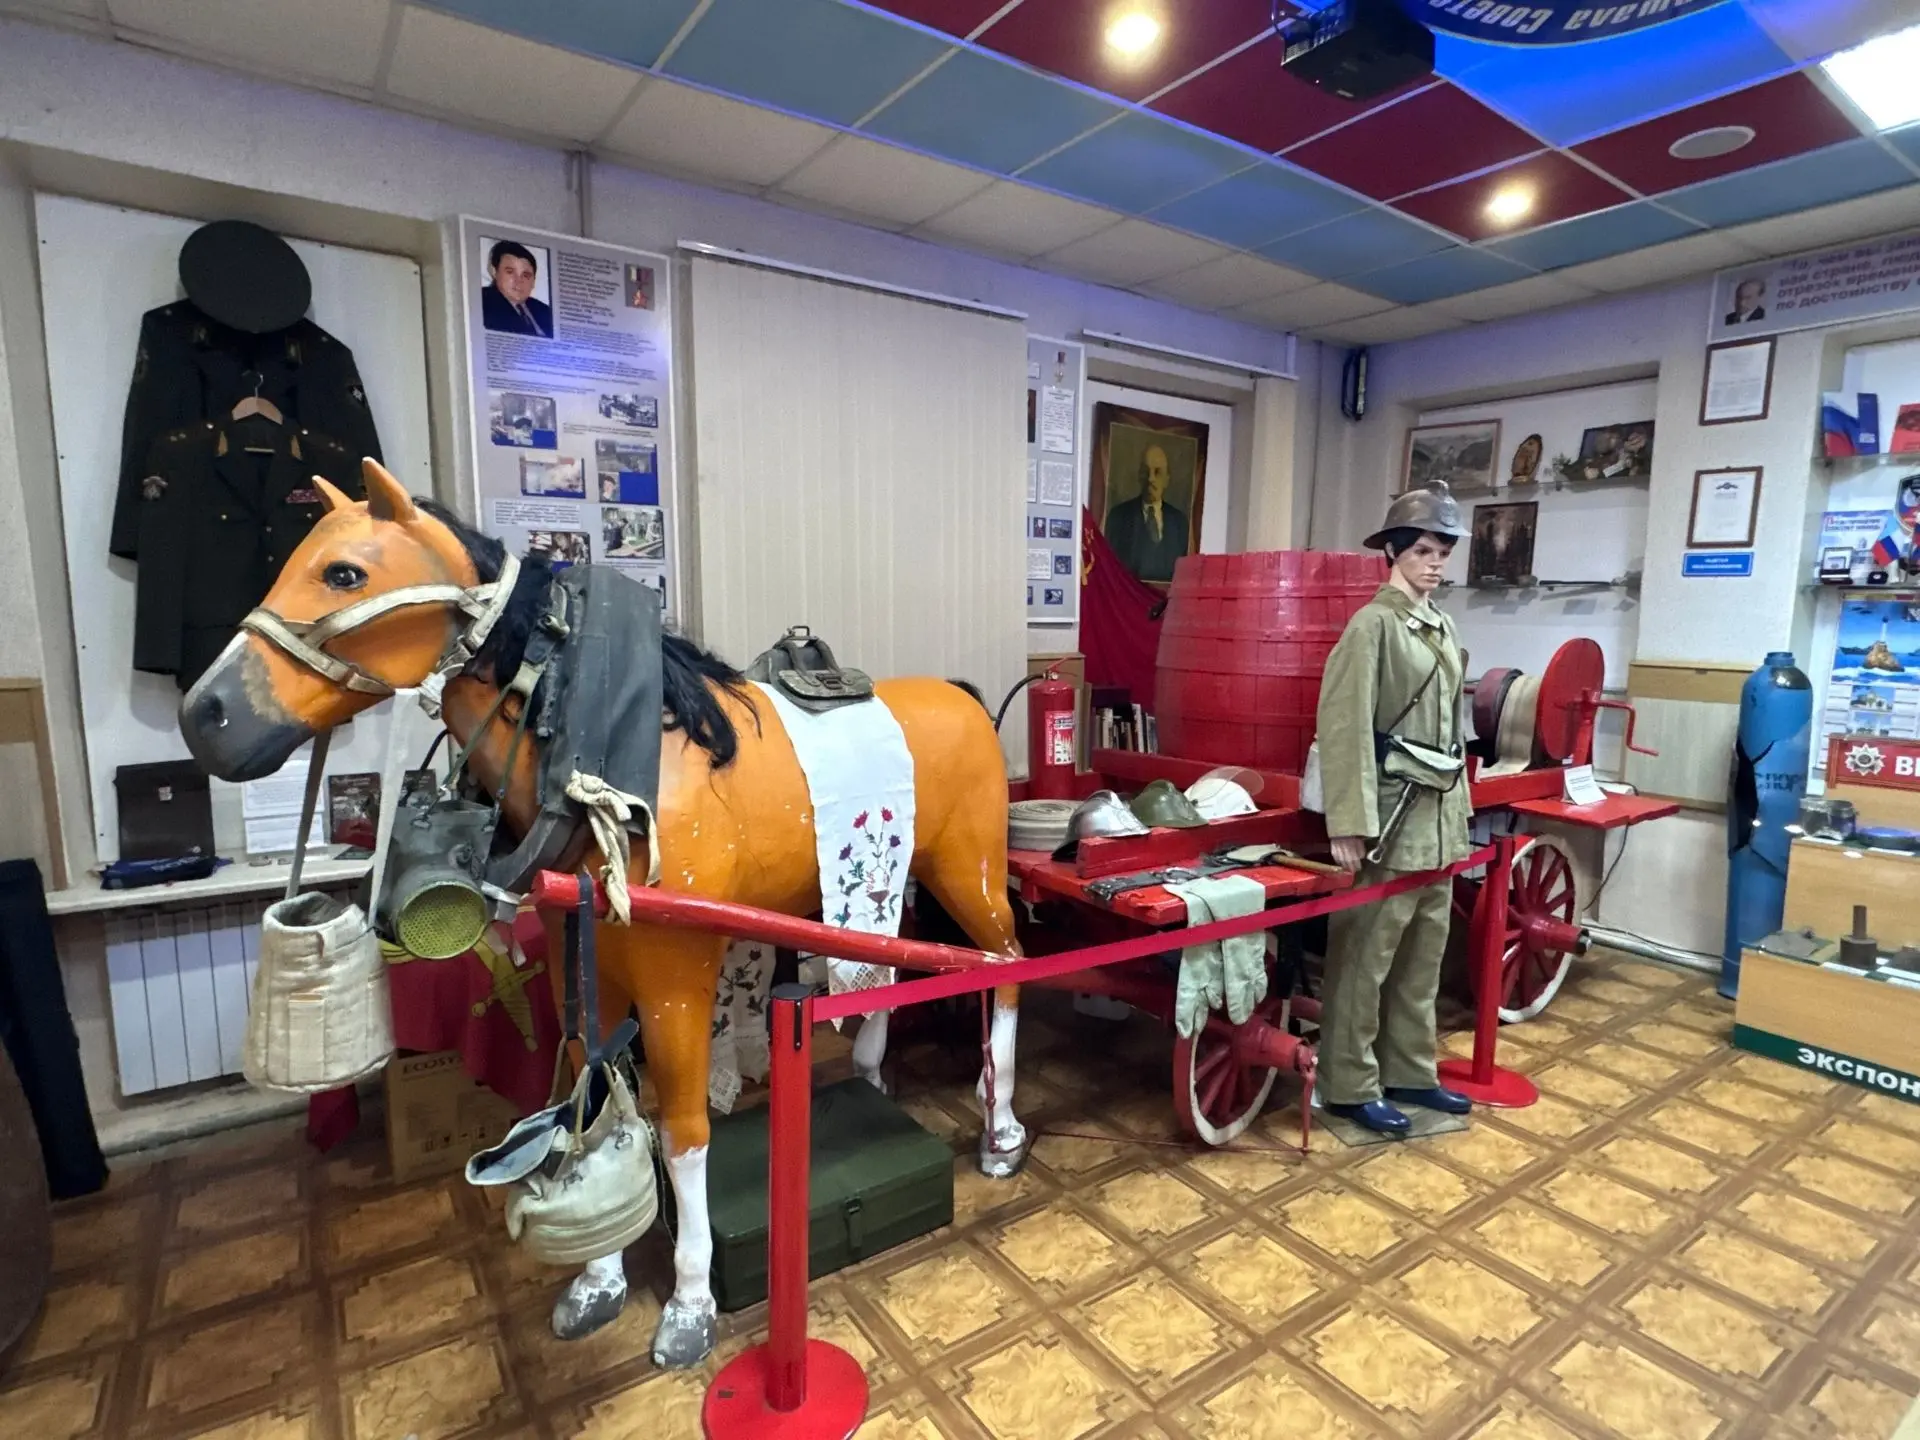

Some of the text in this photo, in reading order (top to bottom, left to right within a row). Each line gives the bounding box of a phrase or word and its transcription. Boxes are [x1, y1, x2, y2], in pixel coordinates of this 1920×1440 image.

[1563, 0, 1693, 30] шала
[1776, 300, 1796, 312] по
[1799, 279, 1911, 309] достоинству
[1777, 280, 1840, 298] отрезок
